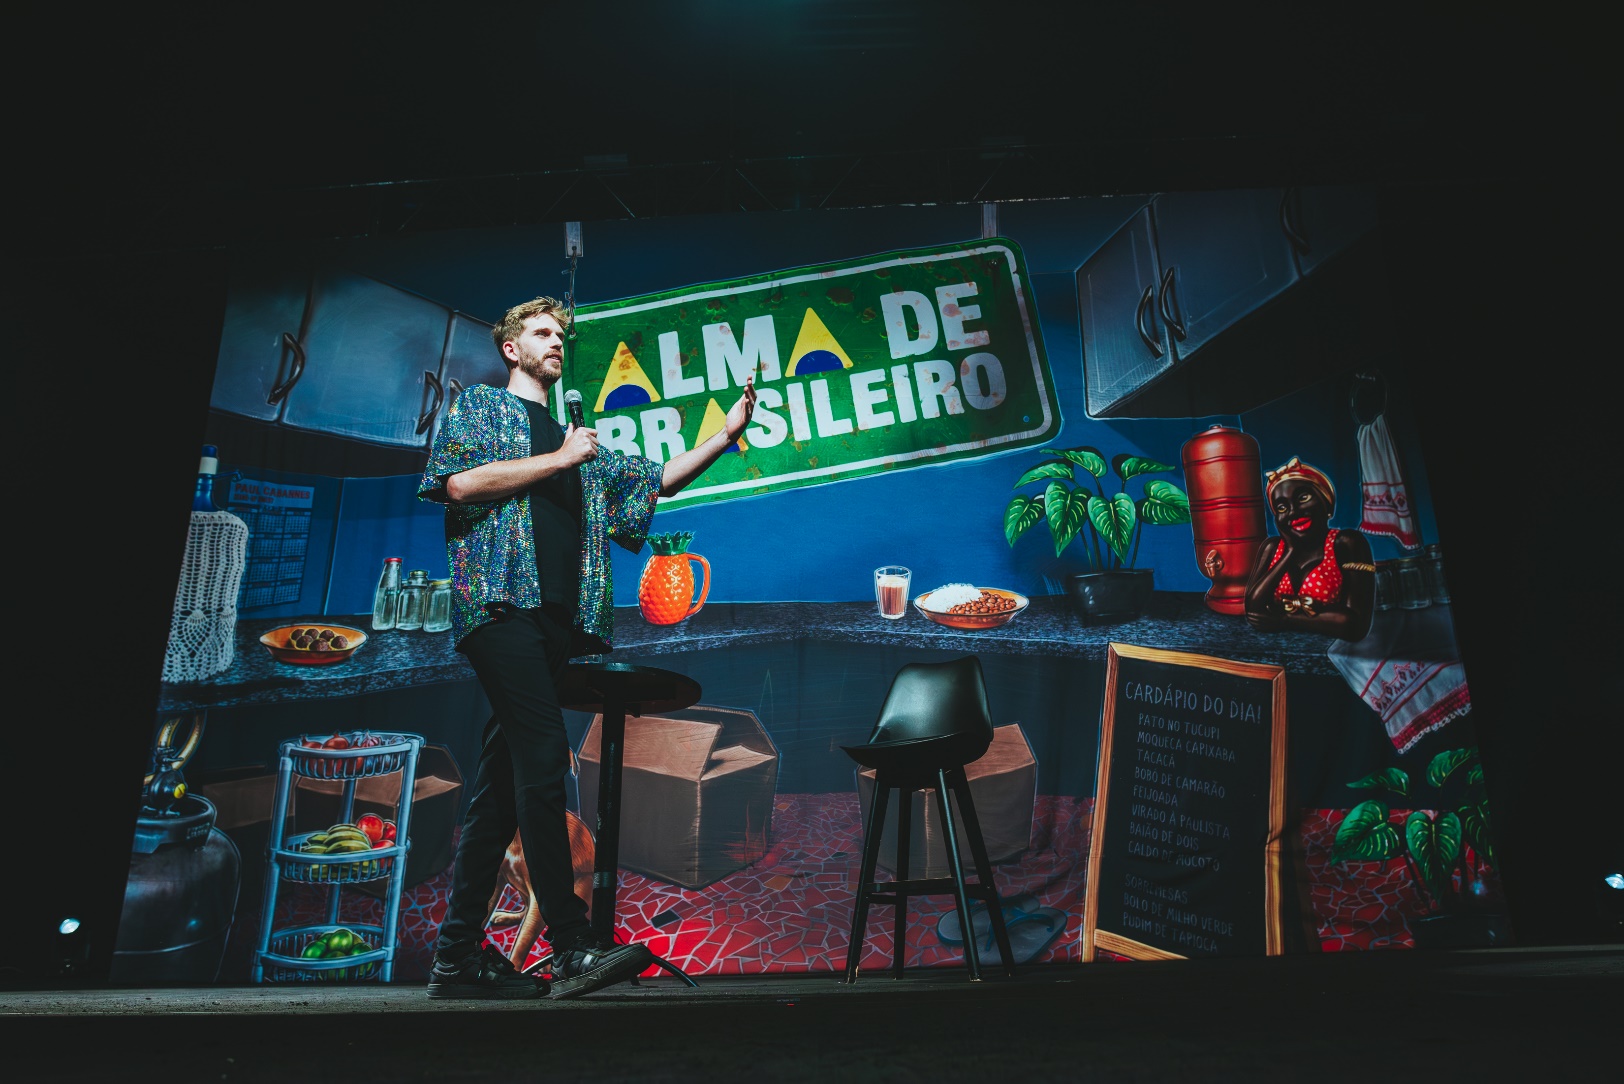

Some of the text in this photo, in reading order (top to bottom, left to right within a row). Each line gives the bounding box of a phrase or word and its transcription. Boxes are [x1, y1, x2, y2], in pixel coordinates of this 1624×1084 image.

[594, 281, 991, 412] ALMA DE
[595, 352, 1007, 465] BRASILEIRO
[235, 483, 260, 495] PAUL
[1125, 681, 1262, 725] CARDÁPIO DO DIA!
[1138, 712, 1220, 740] PATO NO TUCUPI
[1137, 731, 1236, 763] MOQUECA CAPIXABA
[1133, 784, 1179, 807] FEIJOADA
[1134, 766, 1225, 799] BOBÓ DE CAMARÃO
[1129, 821, 1199, 851] BAIÃO DE DOIS
[1132, 804, 1166, 823] VIRADO
[1180, 814, 1231, 840] PAULISTA
[1128, 840, 1159, 858] CALDO
[1162, 850, 1173, 864] DE
[1123, 891, 1234, 937] BOLO DE MILHO VERDE
[1122, 911, 1219, 953] PUDIM DE TAPIOCA
